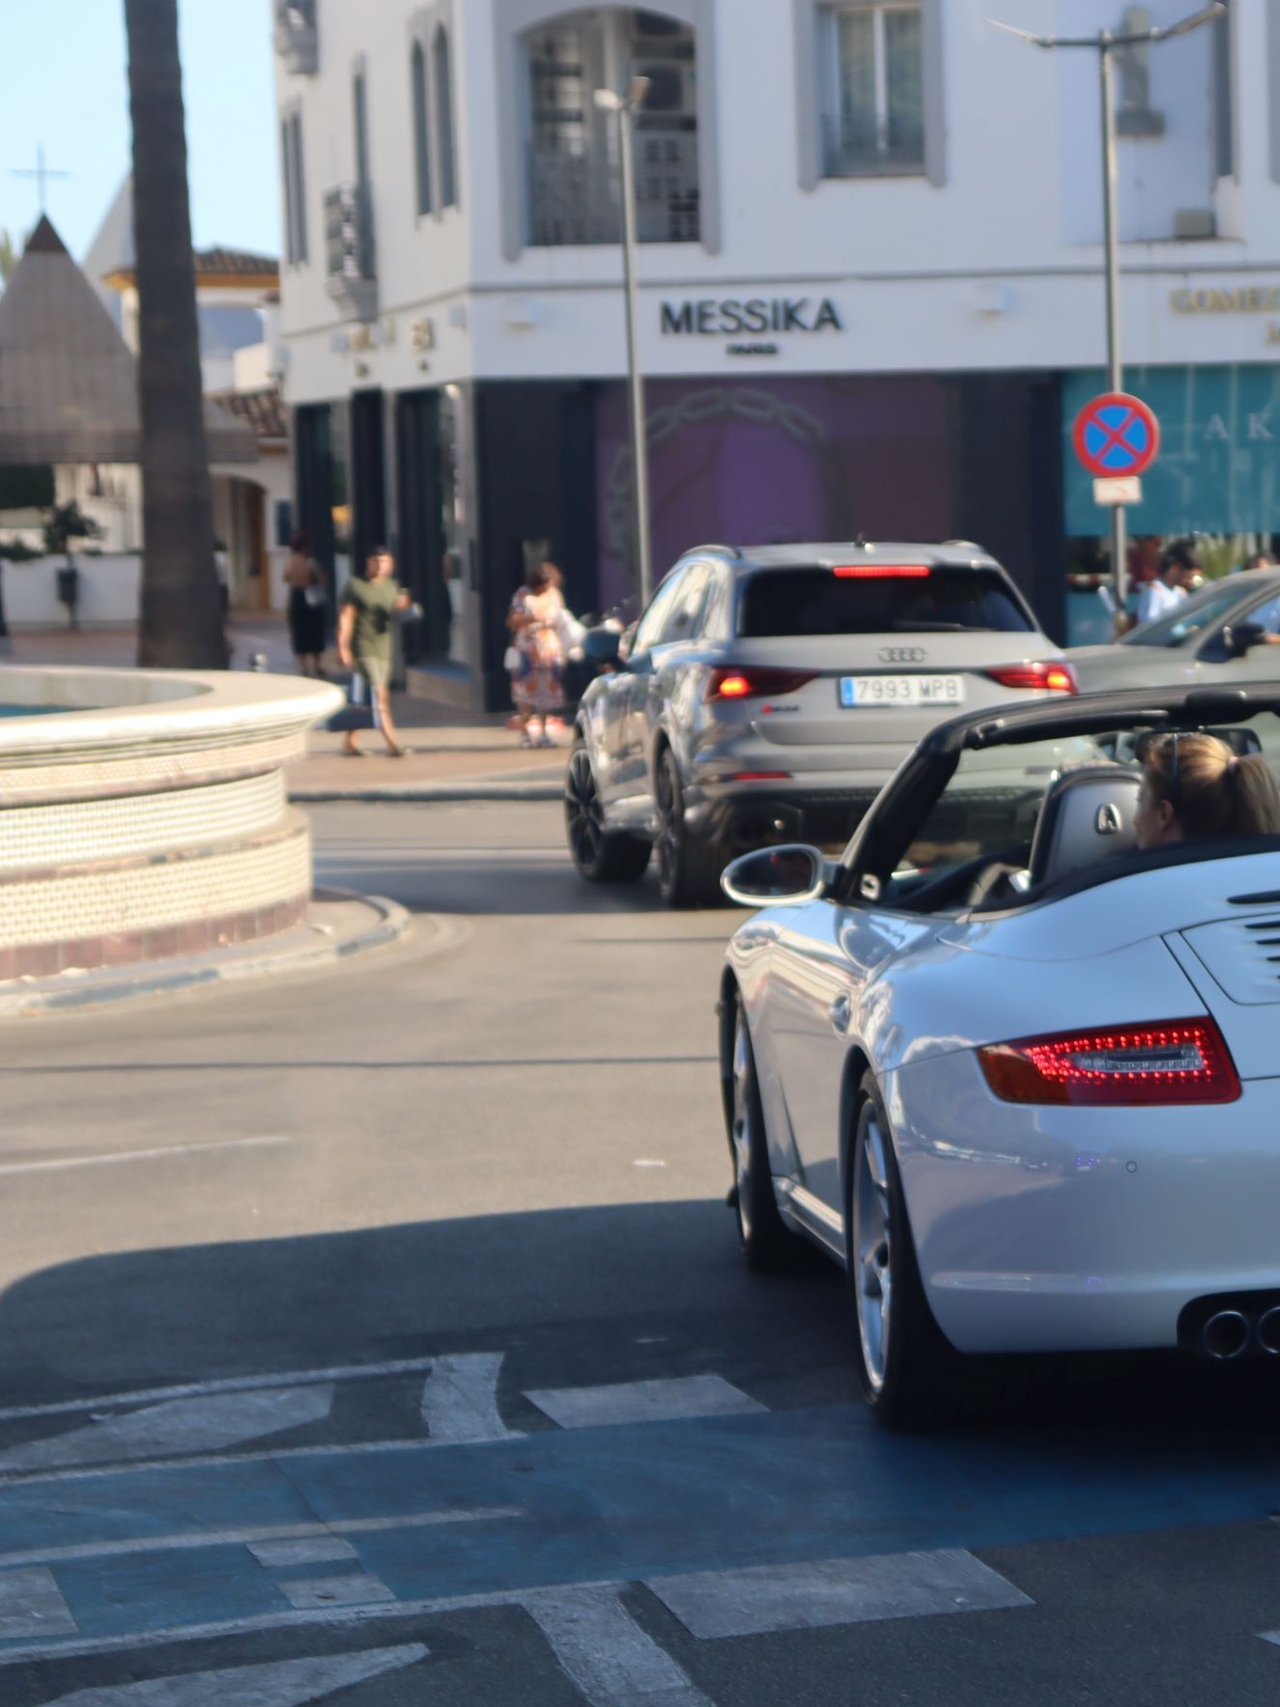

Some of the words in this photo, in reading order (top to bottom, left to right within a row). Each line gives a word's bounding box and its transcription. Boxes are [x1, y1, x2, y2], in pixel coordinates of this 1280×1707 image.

[661, 299, 842, 334] MESSIKA
[857, 679, 912, 700] 7993
[918, 678, 958, 698] MPB
